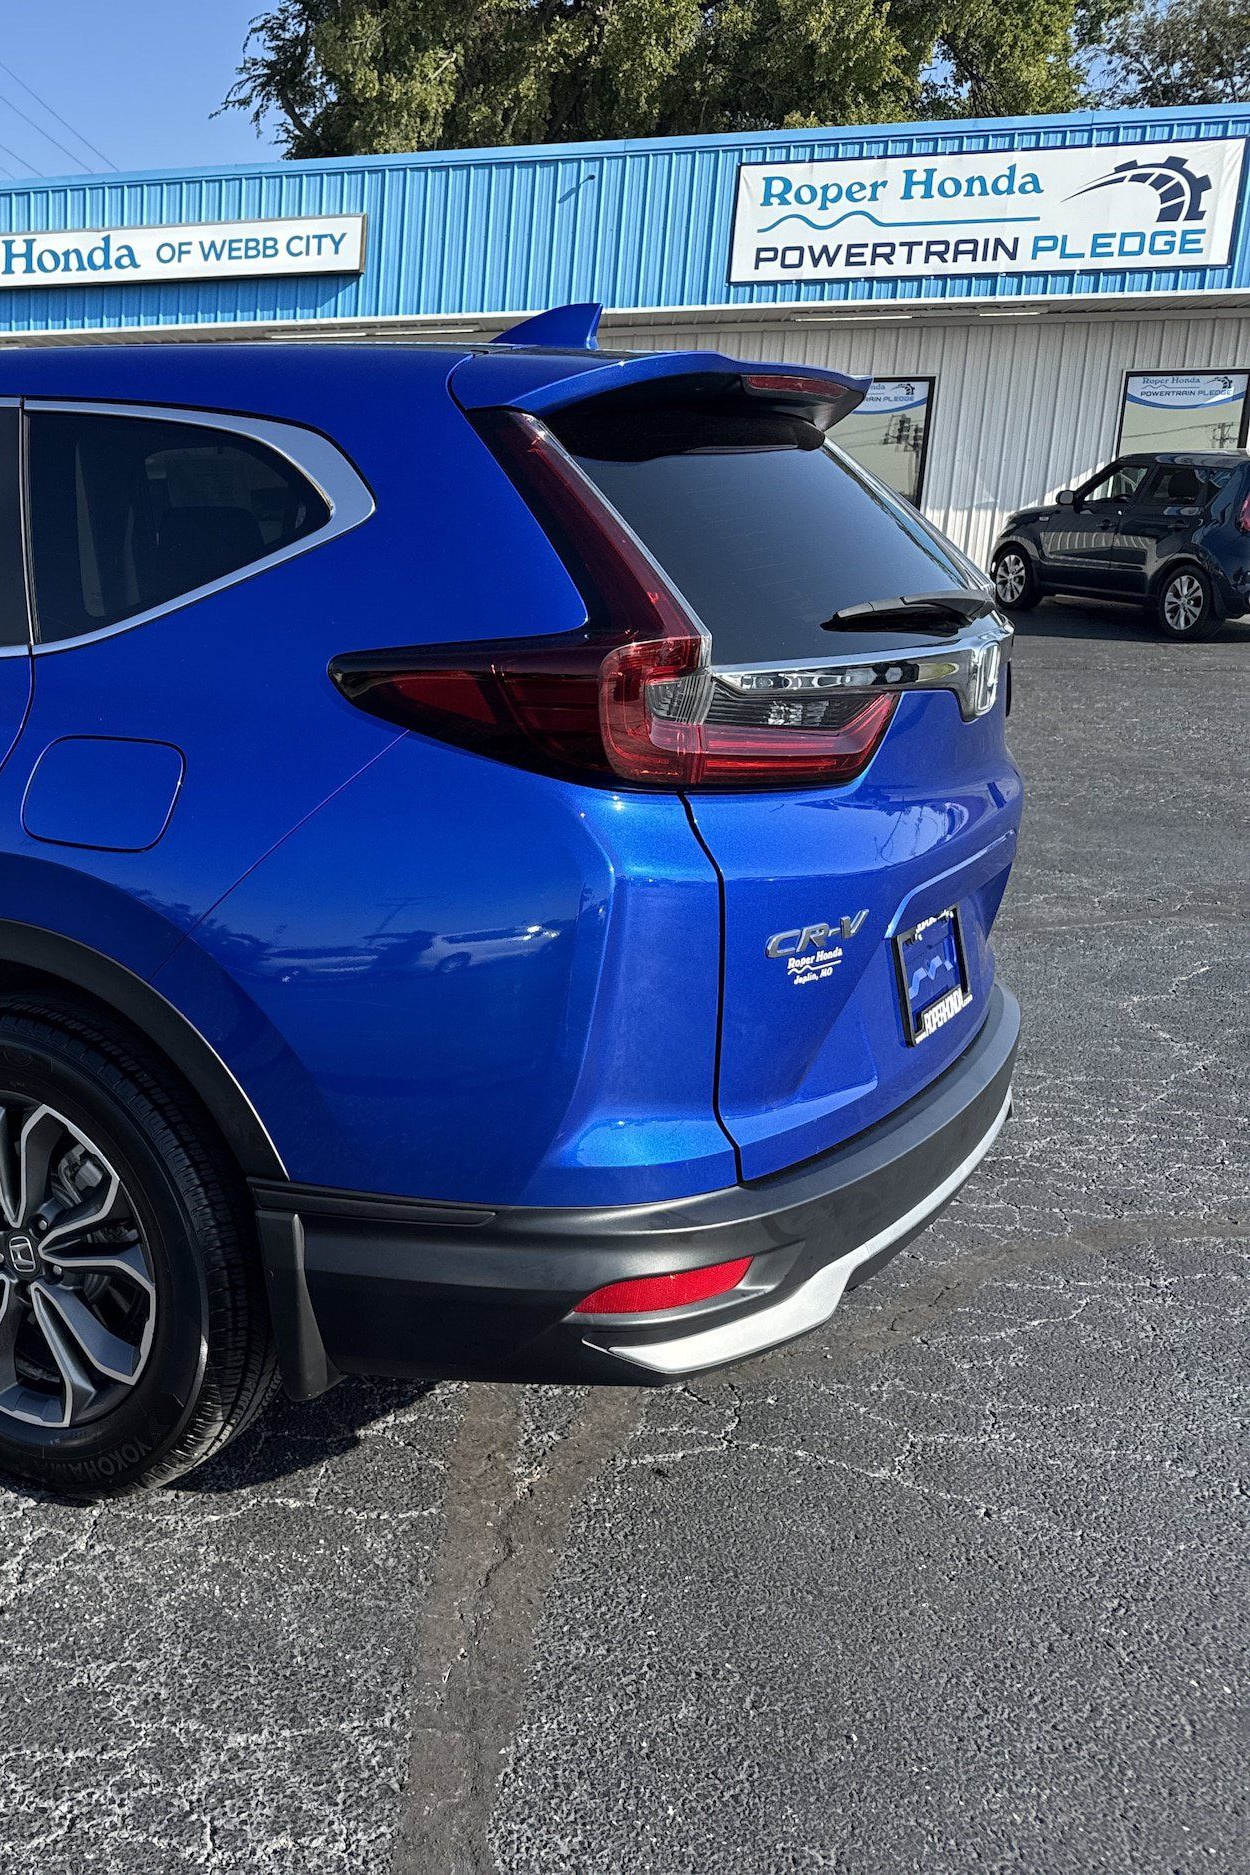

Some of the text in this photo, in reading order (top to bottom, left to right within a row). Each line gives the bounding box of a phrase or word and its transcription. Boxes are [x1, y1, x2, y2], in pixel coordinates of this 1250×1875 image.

[759, 163, 1044, 211] Roper Honda
[1, 234, 140, 275] Honda
[156, 240, 192, 264] OF
[199, 237, 279, 263] WEBB
[285, 232, 348, 257] CITY
[754, 228, 1207, 271] POWERTRAIN PLEDGE
[1172, 376, 1201, 384] Honda
[765, 908, 870, 958] CR-V
[787, 946, 843, 969] Roper Honda
[34, 1437, 152, 1481] YOKOHAM
